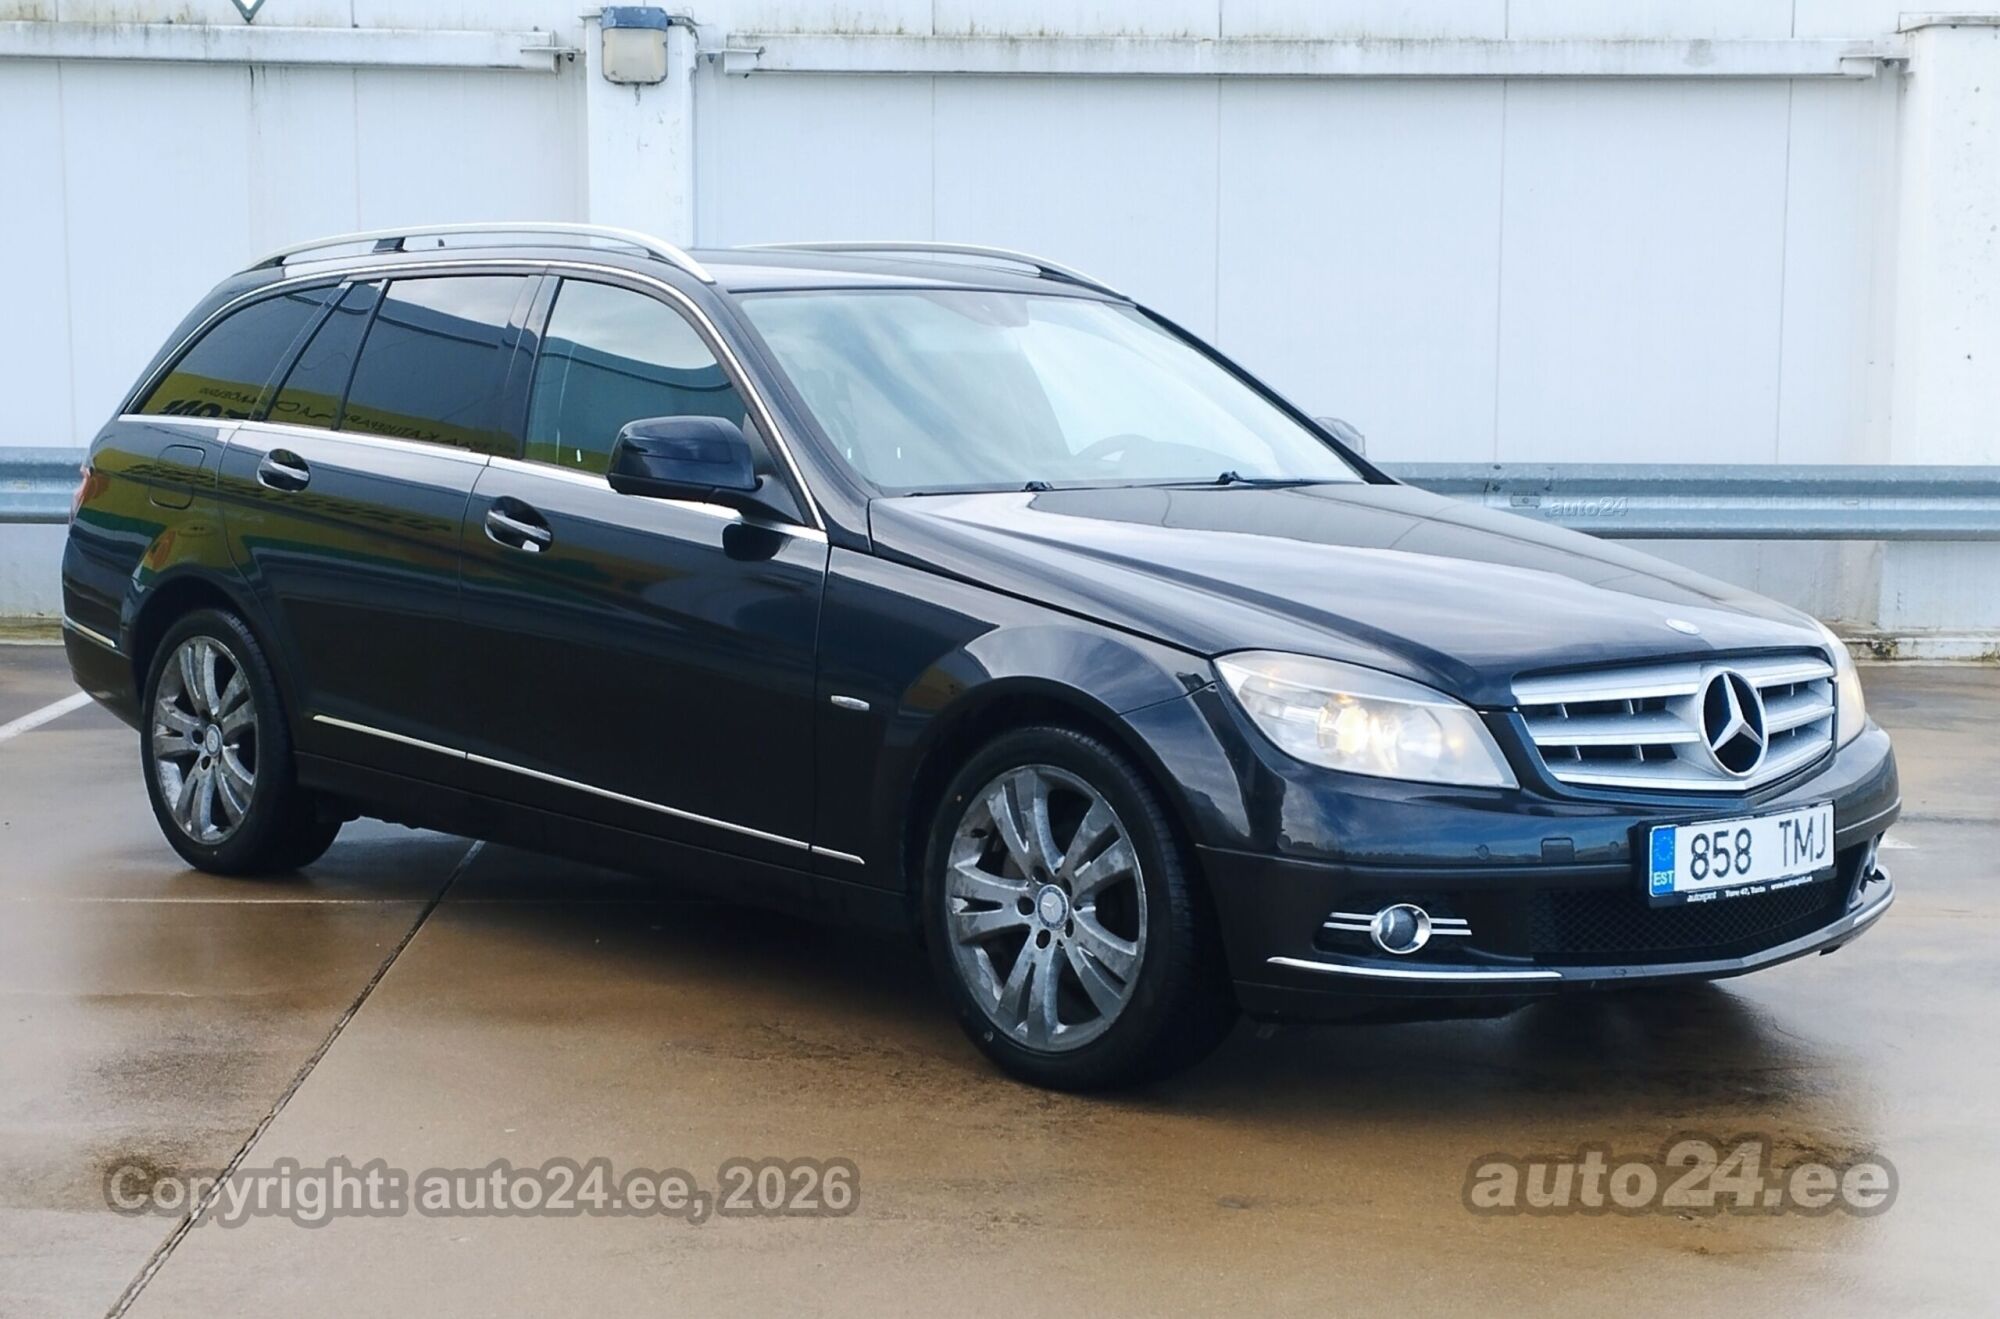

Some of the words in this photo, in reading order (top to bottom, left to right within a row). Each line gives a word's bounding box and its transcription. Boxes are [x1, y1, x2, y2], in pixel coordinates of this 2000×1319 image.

[1690, 827, 1753, 881] 858
[1778, 812, 1827, 867] TMJ
[1653, 870, 1675, 886] EST
